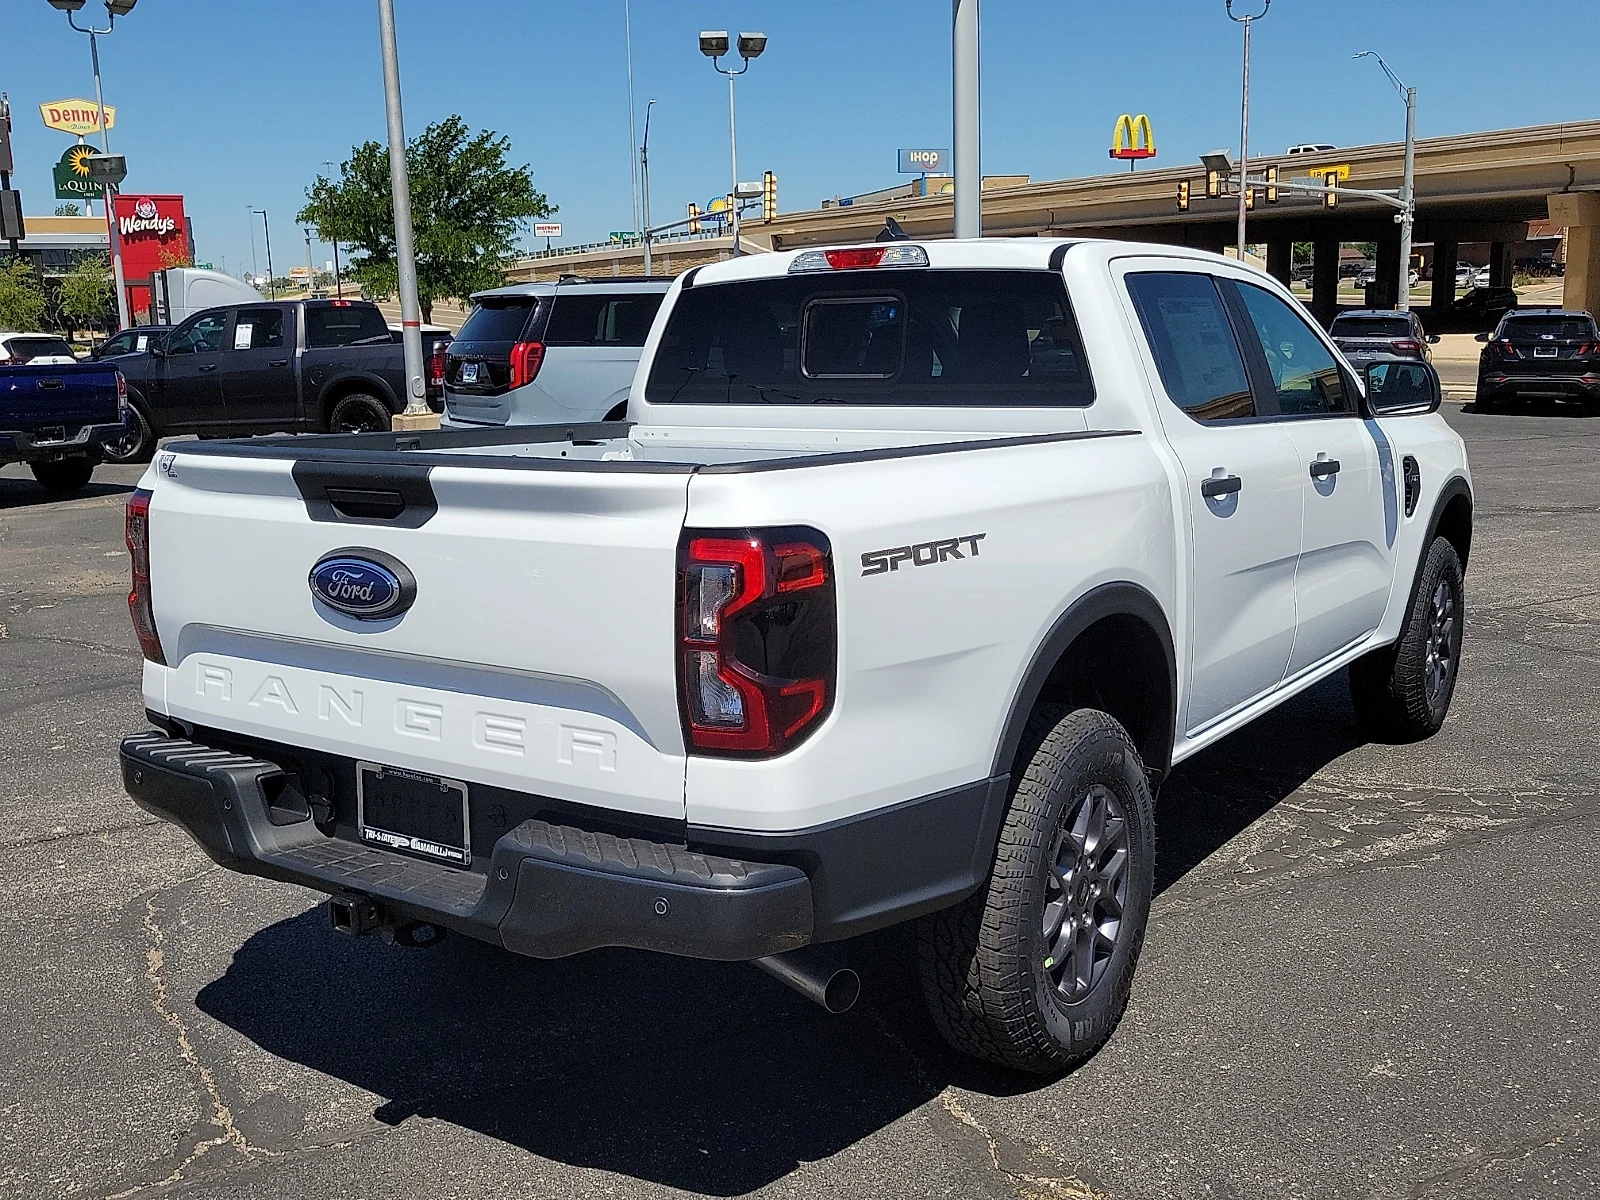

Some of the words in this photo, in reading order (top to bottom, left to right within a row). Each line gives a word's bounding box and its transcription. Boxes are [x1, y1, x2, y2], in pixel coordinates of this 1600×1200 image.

[48, 108, 110, 126] Dennys
[119, 213, 175, 235] Wendy's
[860, 532, 987, 577] SPORT
[328, 569, 375, 601] Ford
[195, 662, 617, 773] RANGER
[364, 828, 394, 844] TRI-STATE
